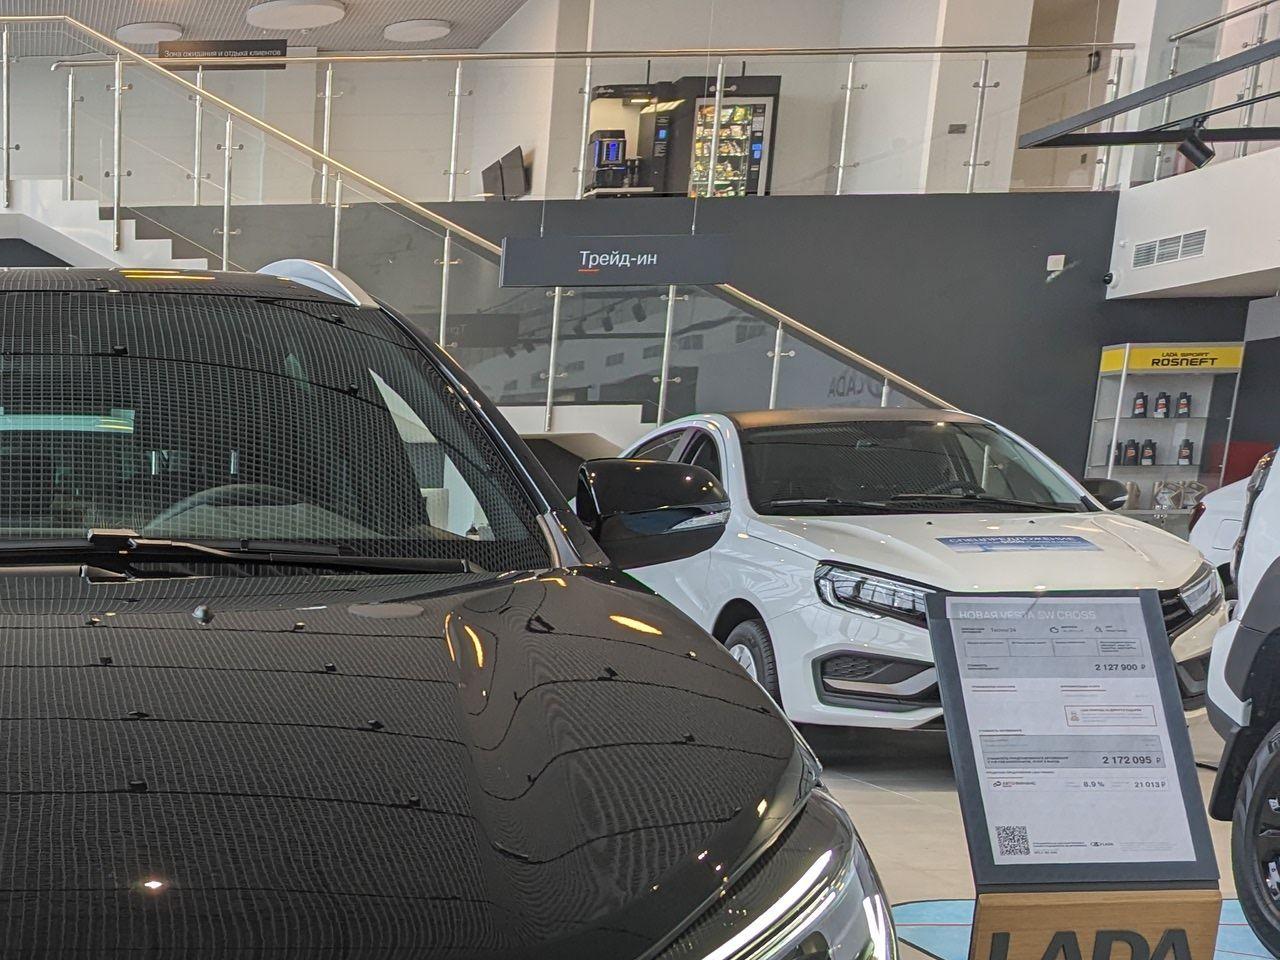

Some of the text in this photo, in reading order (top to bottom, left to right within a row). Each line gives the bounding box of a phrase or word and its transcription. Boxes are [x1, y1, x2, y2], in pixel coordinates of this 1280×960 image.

[579, 250, 657, 268] Трейд-ин
[1151, 357, 1218, 366] ROSNEFT
[959, 610, 998, 619] НОВАЯ
[1056, 610, 1096, 620] CROSS
[1095, 663, 1101, 671] 2
[1104, 663, 1119, 671] 127
[1120, 663, 1138, 671] 900
[1102, 756, 1109, 764] 2
[1112, 756, 1131, 764] 172
[1132, 756, 1152, 764] 095
